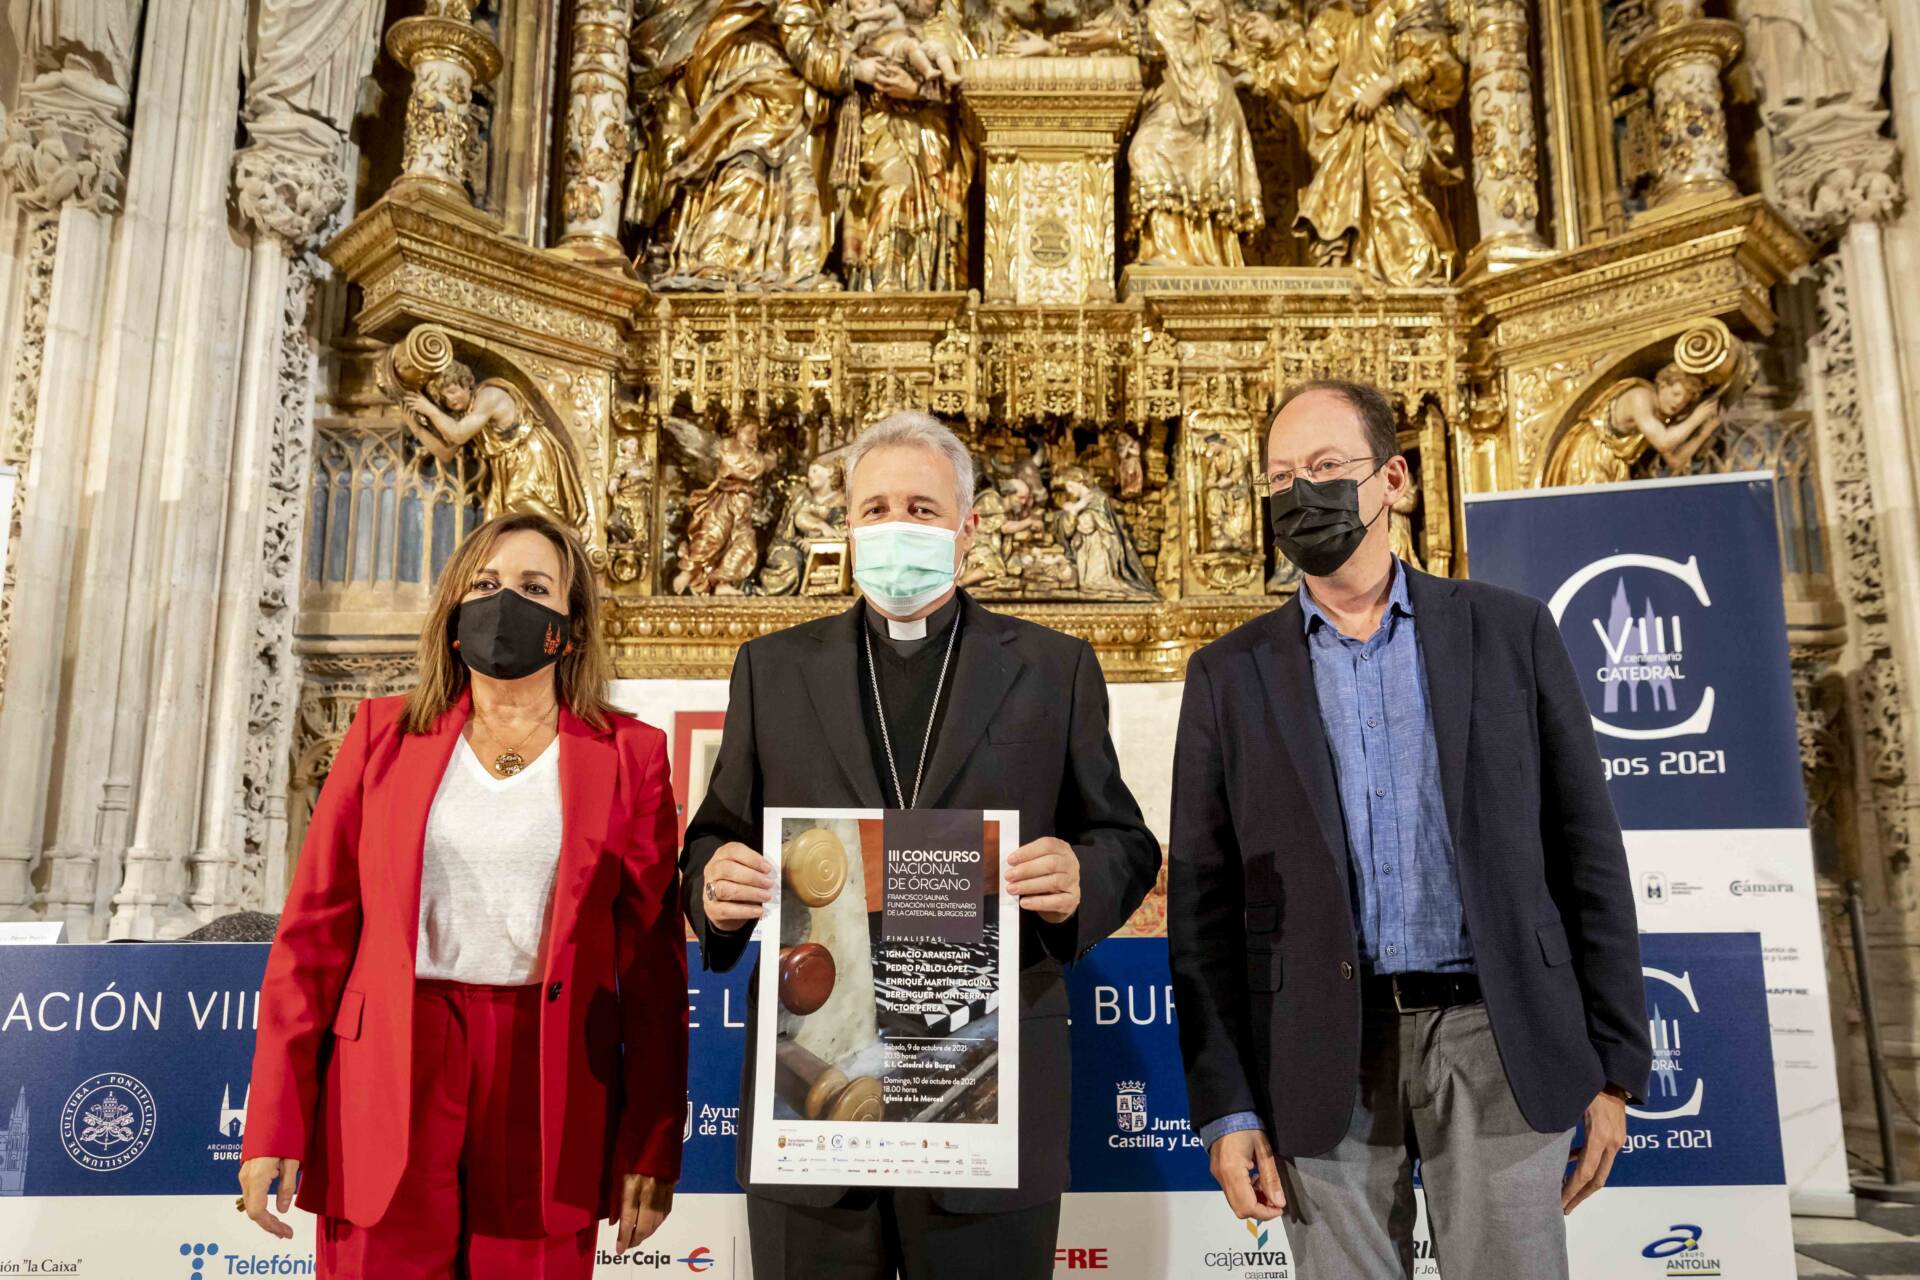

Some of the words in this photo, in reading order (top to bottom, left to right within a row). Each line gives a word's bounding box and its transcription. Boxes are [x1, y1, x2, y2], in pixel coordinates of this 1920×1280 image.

[1592, 615, 1682, 664] VIII
[1624, 652, 1682, 663] centenario
[1596, 665, 1686, 682] CATEDRAL
[1659, 750, 1726, 775] 2021
[888, 850, 900, 862] III
[902, 850, 980, 862] CONCURSO
[888, 862, 959, 875] NACIONAL
[888, 878, 906, 890] DE
[908, 876, 970, 890] ÓRGANO
[886, 950, 921, 958] IGNACIO
[922, 951, 970, 959] ARAKISTAIN
[942, 963, 968, 972] LÓPEZ
[886, 978, 922, 987] ENRIQUE
[886, 991, 935, 999] BERENGUER
[936, 992, 990, 1000] MONTSERRAT
[2, 981, 162, 1032] ACIÓN
[188, 990, 260, 1030] VIII
[886, 1002, 915, 1011] VÍCTOR
[884, 1043, 906, 1051] Sábado,
[934, 1062, 955, 1071] Burgos
[1652, 1060, 1683, 1070] DRAL
[884, 1077, 912, 1086] Domingo,
[884, 1095, 903, 1103] Iglesia
[64, 1087, 89, 1137] CULTURA
[110, 1076, 152, 1136] PONTIFICIUM
[699, 1120, 717, 1135] de
[1108, 1135, 1164, 1148] Castilla
[1168, 1137, 1177, 1151] y
[1667, 1130, 1712, 1148] 2021
[68, 1142, 80, 1155] DE
[82, 1141, 144, 1168] CONSILIUM
[224, 1254, 316, 1275] Telefóni
[1204, 1248, 1287, 1271] cajaviva
[1666, 1260, 1720, 1269] ANTOLIN
[1244, 1270, 1288, 1280] cajarural
